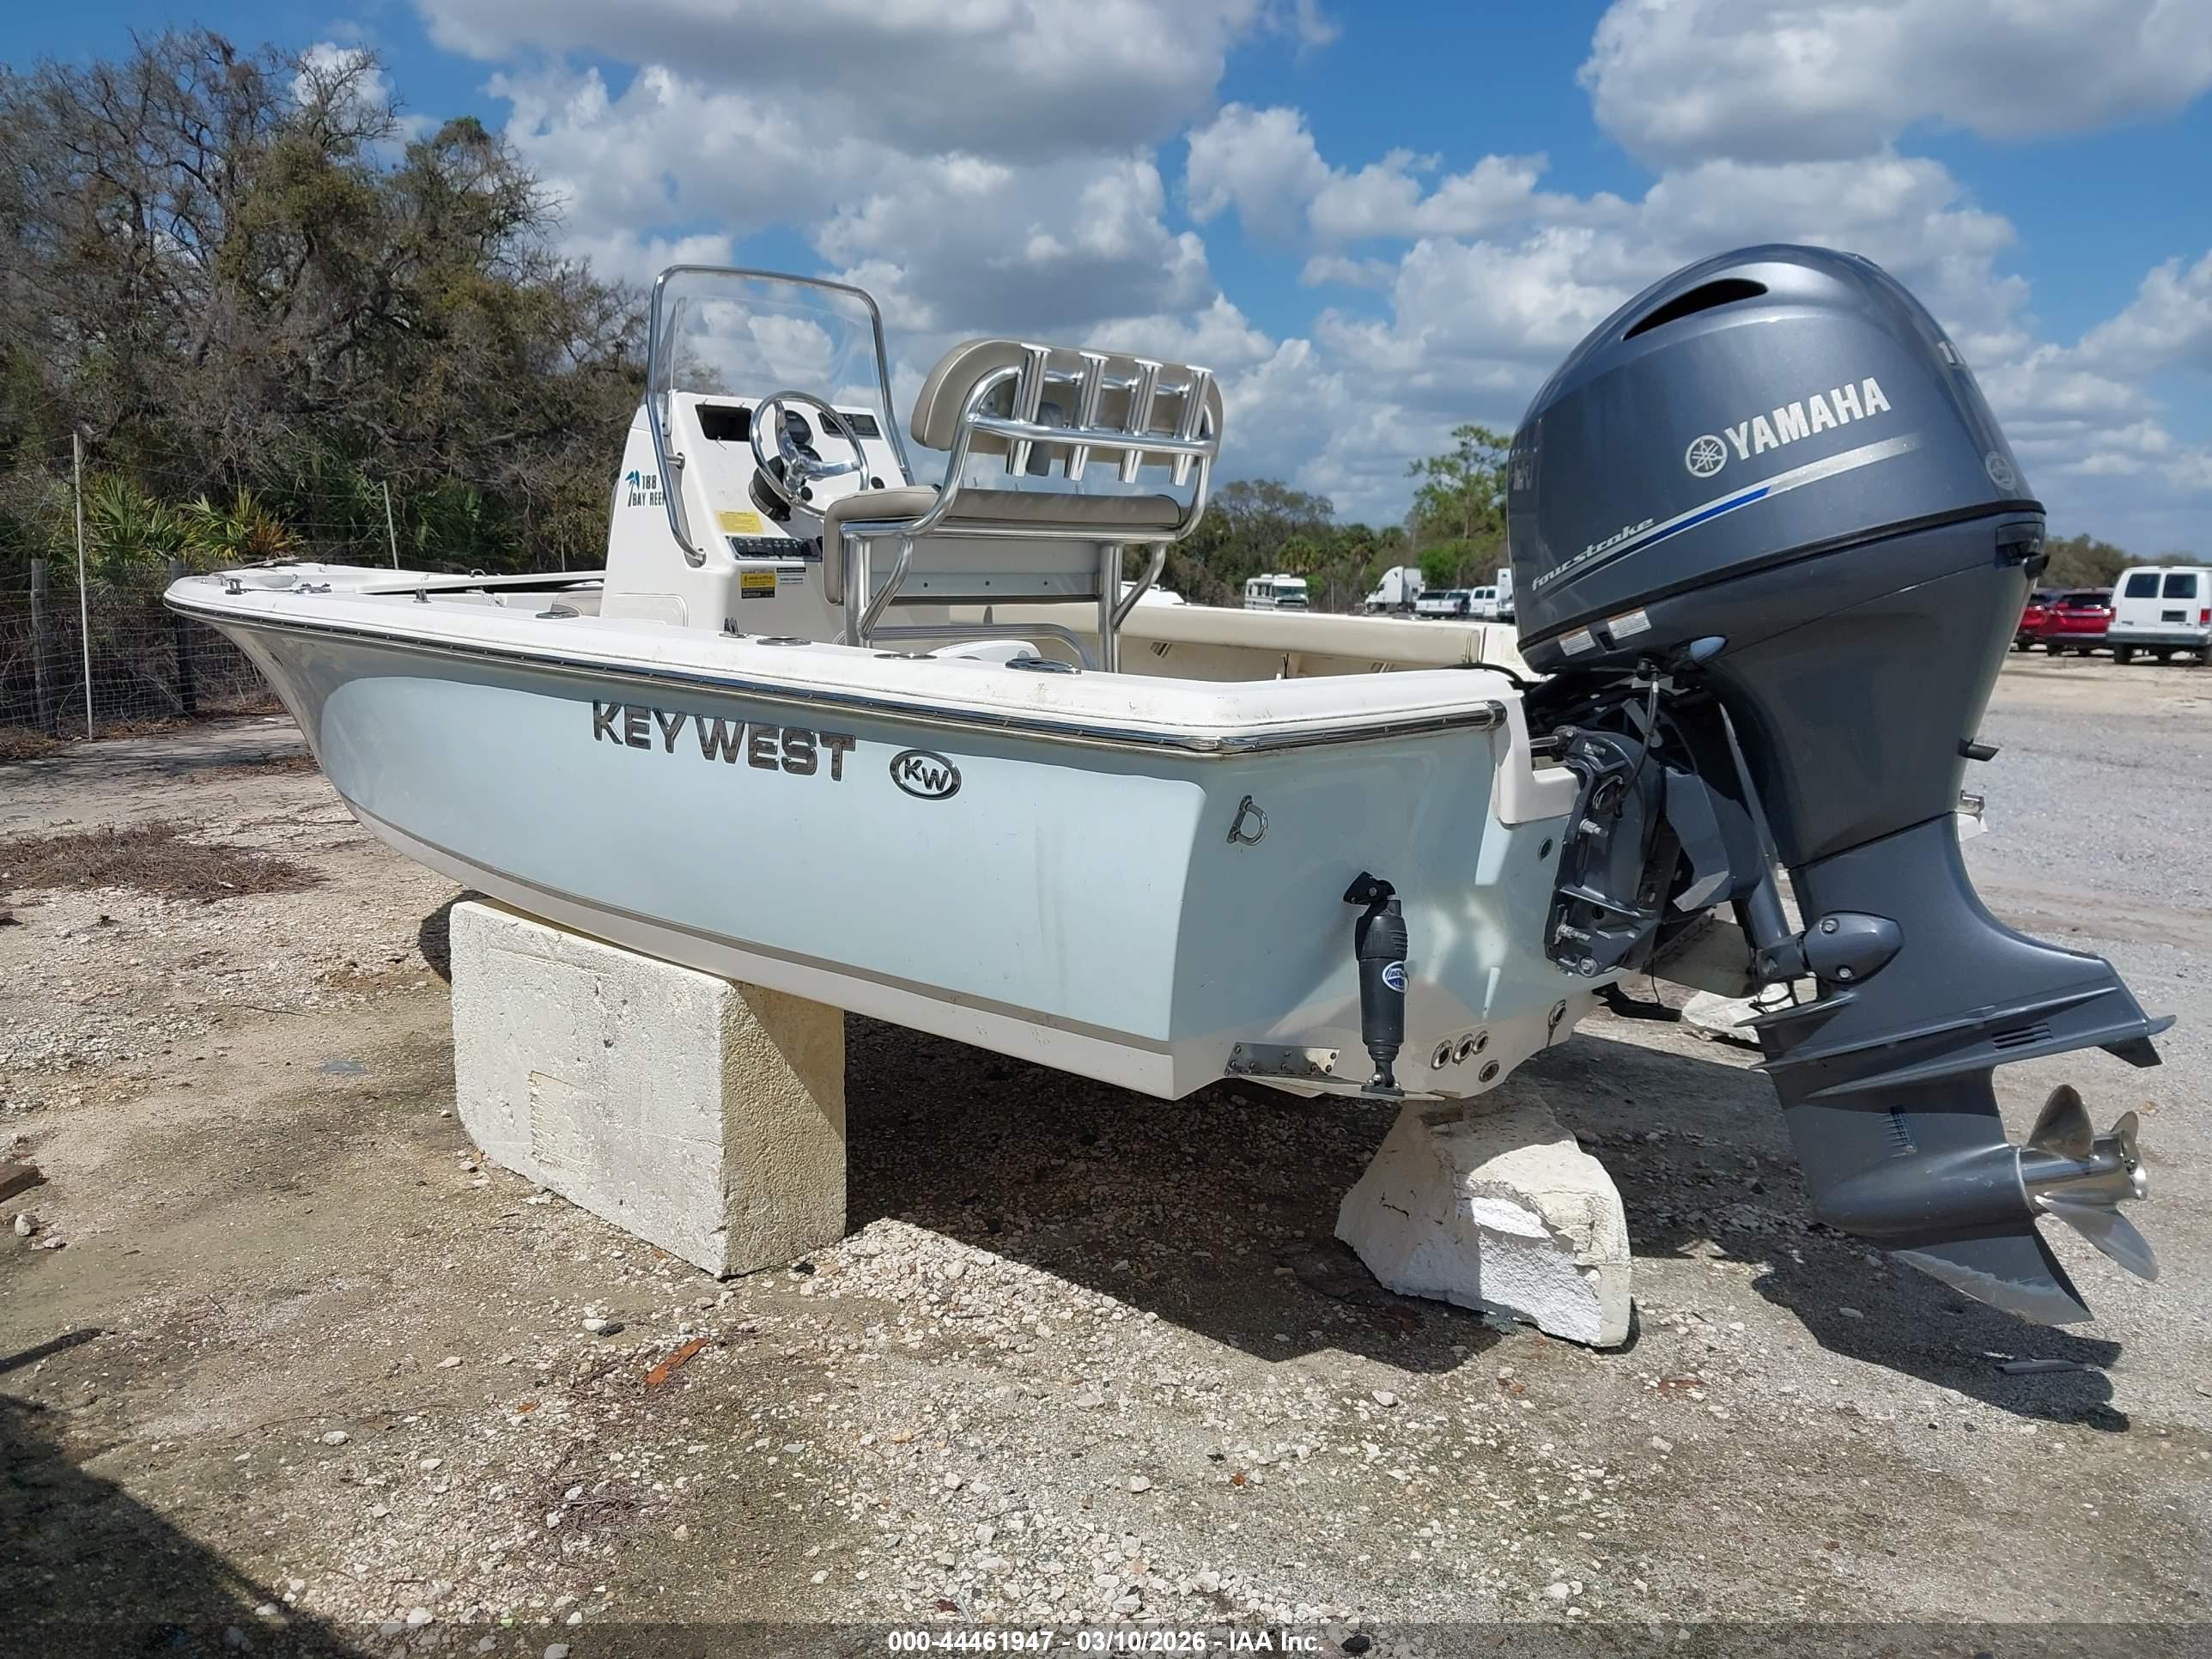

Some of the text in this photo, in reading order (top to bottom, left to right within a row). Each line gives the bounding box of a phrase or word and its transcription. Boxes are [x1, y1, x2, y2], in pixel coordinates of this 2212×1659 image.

[1724, 377, 1891, 460] YAMAHA
[632, 492, 647, 507] BAY
[642, 474, 657, 490] 188
[592, 700, 856, 781] KEY WEST
[904, 757, 949, 792] KW
